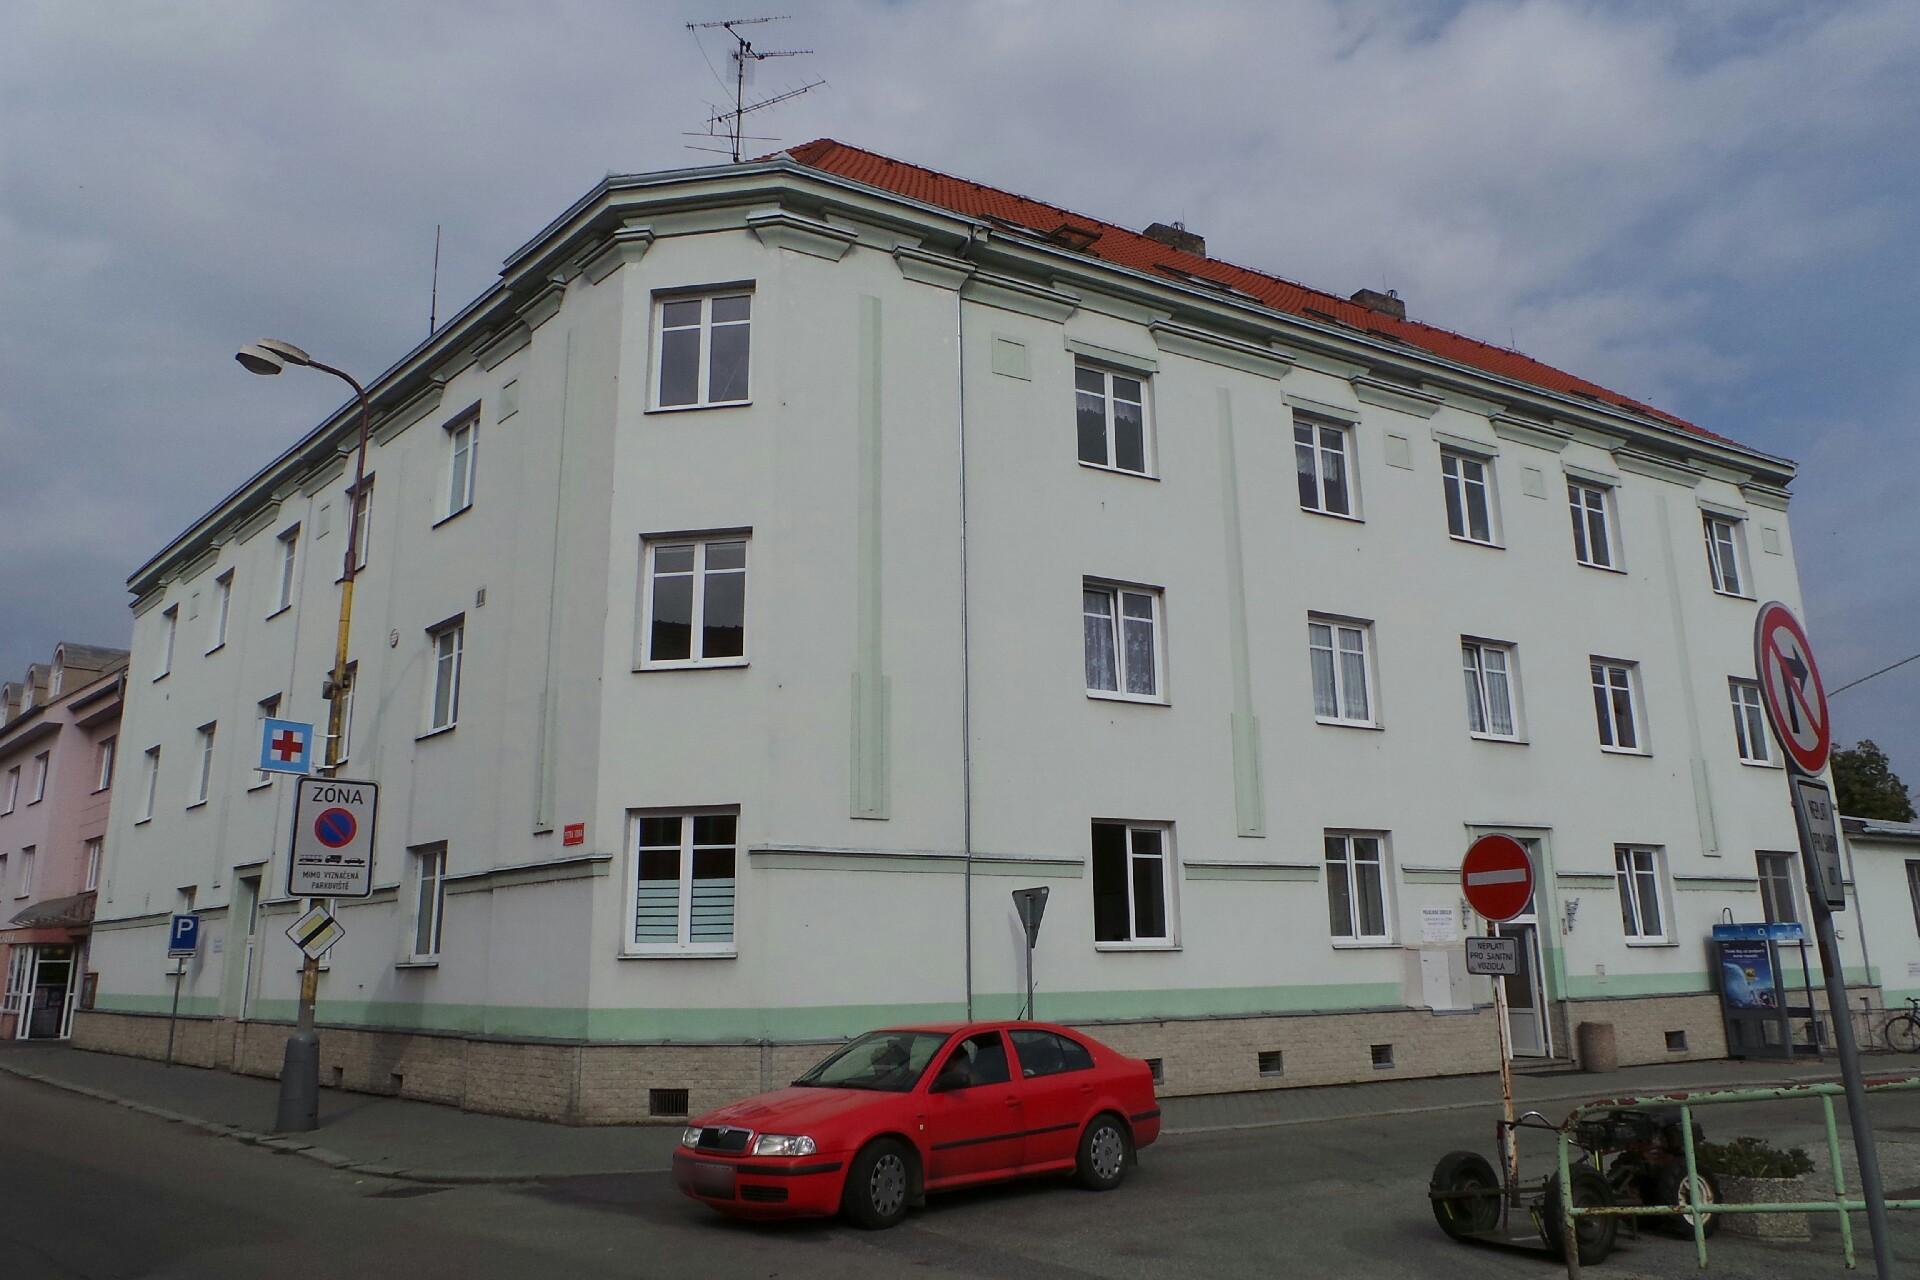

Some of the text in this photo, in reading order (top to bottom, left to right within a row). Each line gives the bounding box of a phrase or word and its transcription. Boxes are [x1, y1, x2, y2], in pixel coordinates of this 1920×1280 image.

[312, 785, 364, 804] ZÓNA
[176, 918, 194, 939] P
[1477, 942, 1504, 950] NEPLATÍ
[1470, 952, 1484, 960] PRO
[1478, 962, 1505, 970] VOZIDLA
